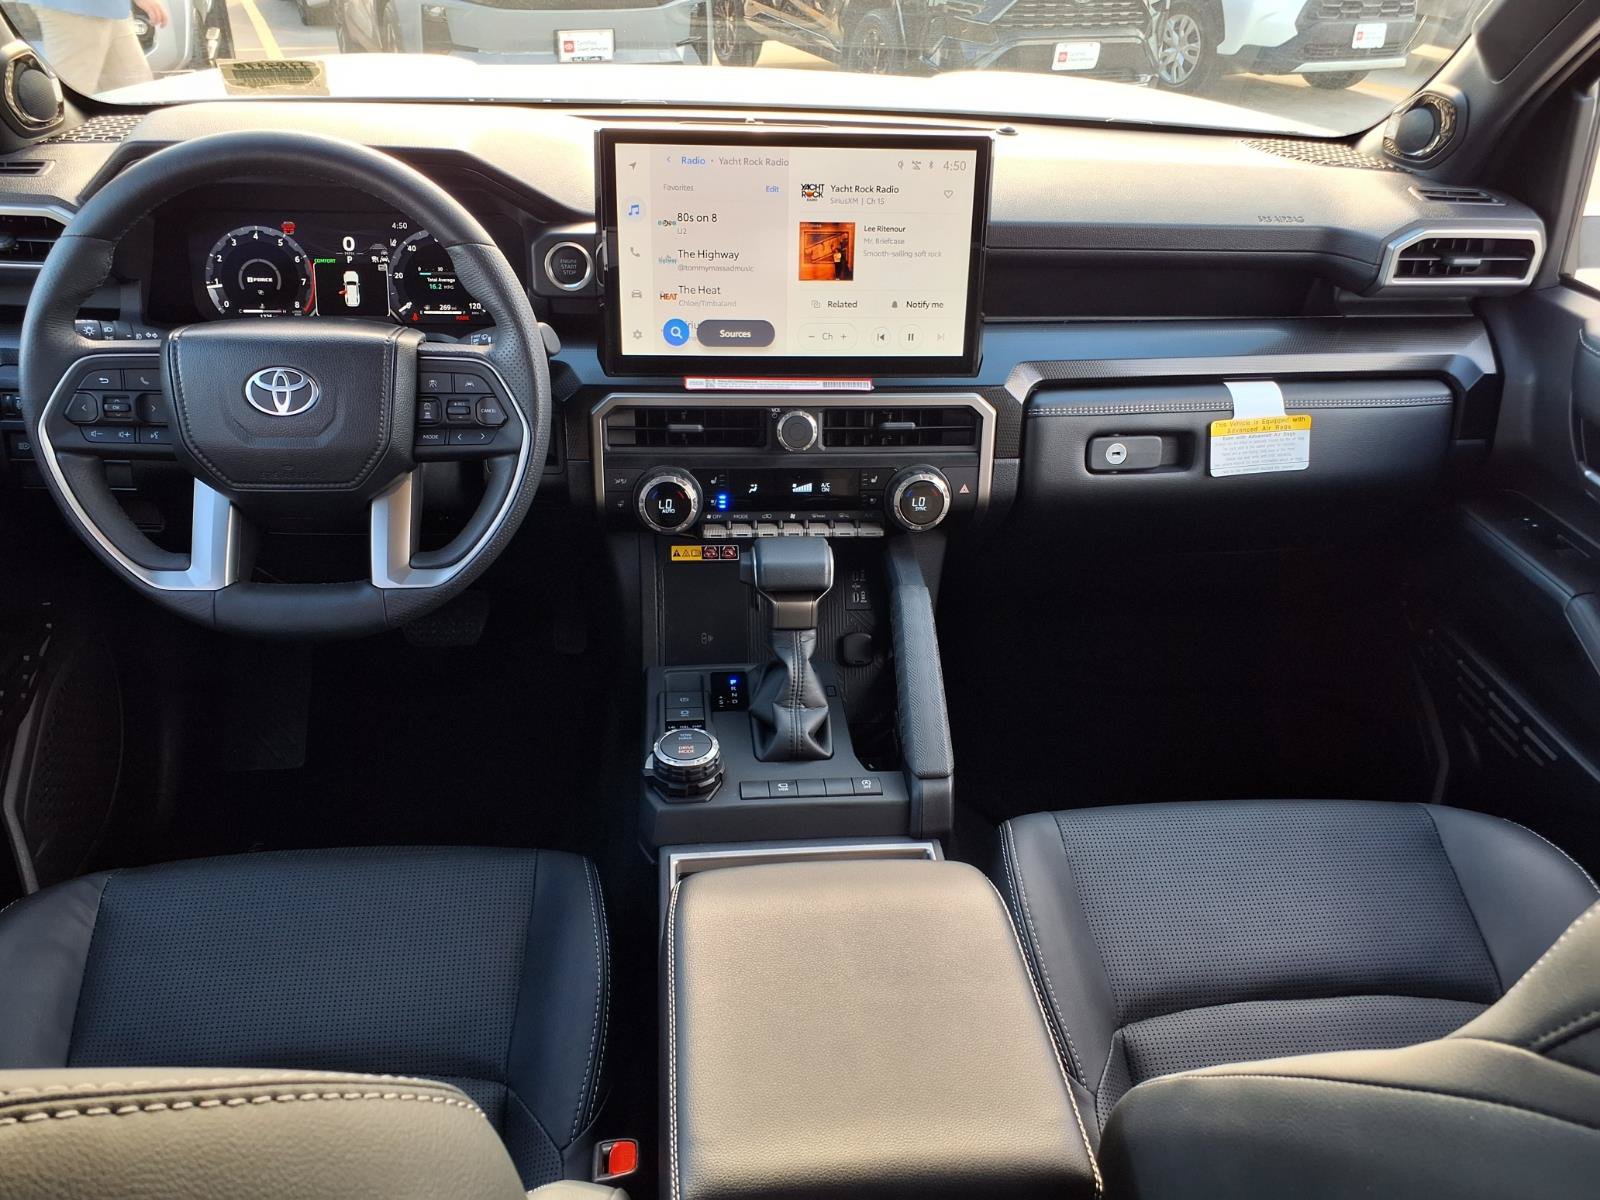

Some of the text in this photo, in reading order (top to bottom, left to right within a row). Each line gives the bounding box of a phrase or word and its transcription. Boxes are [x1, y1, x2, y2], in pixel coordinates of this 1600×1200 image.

[681, 157, 789, 167] Radio Yacht Rock Radio
[943, 160, 967, 171] 4:50
[831, 185, 899, 194] Yacht Rock Radio
[830, 197, 859, 205] SiriusXM
[677, 212, 694, 222] 80s
[711, 213, 718, 222] 8
[877, 225, 906, 233] Ritenour
[278, 239, 284, 247] 5
[342, 236, 355, 252] 0
[407, 244, 417, 252] 40
[347, 255, 353, 263] P
[678, 249, 740, 261] The Highway
[301, 278, 307, 286] 7
[678, 285, 721, 294] The Heat
[827, 300, 858, 308] Related
[906, 300, 930, 310] Notify
[719, 330, 752, 338] Sources
[822, 332, 833, 340] Ch
[658, 499, 672, 509] LO
[911, 496, 926, 507] LO
